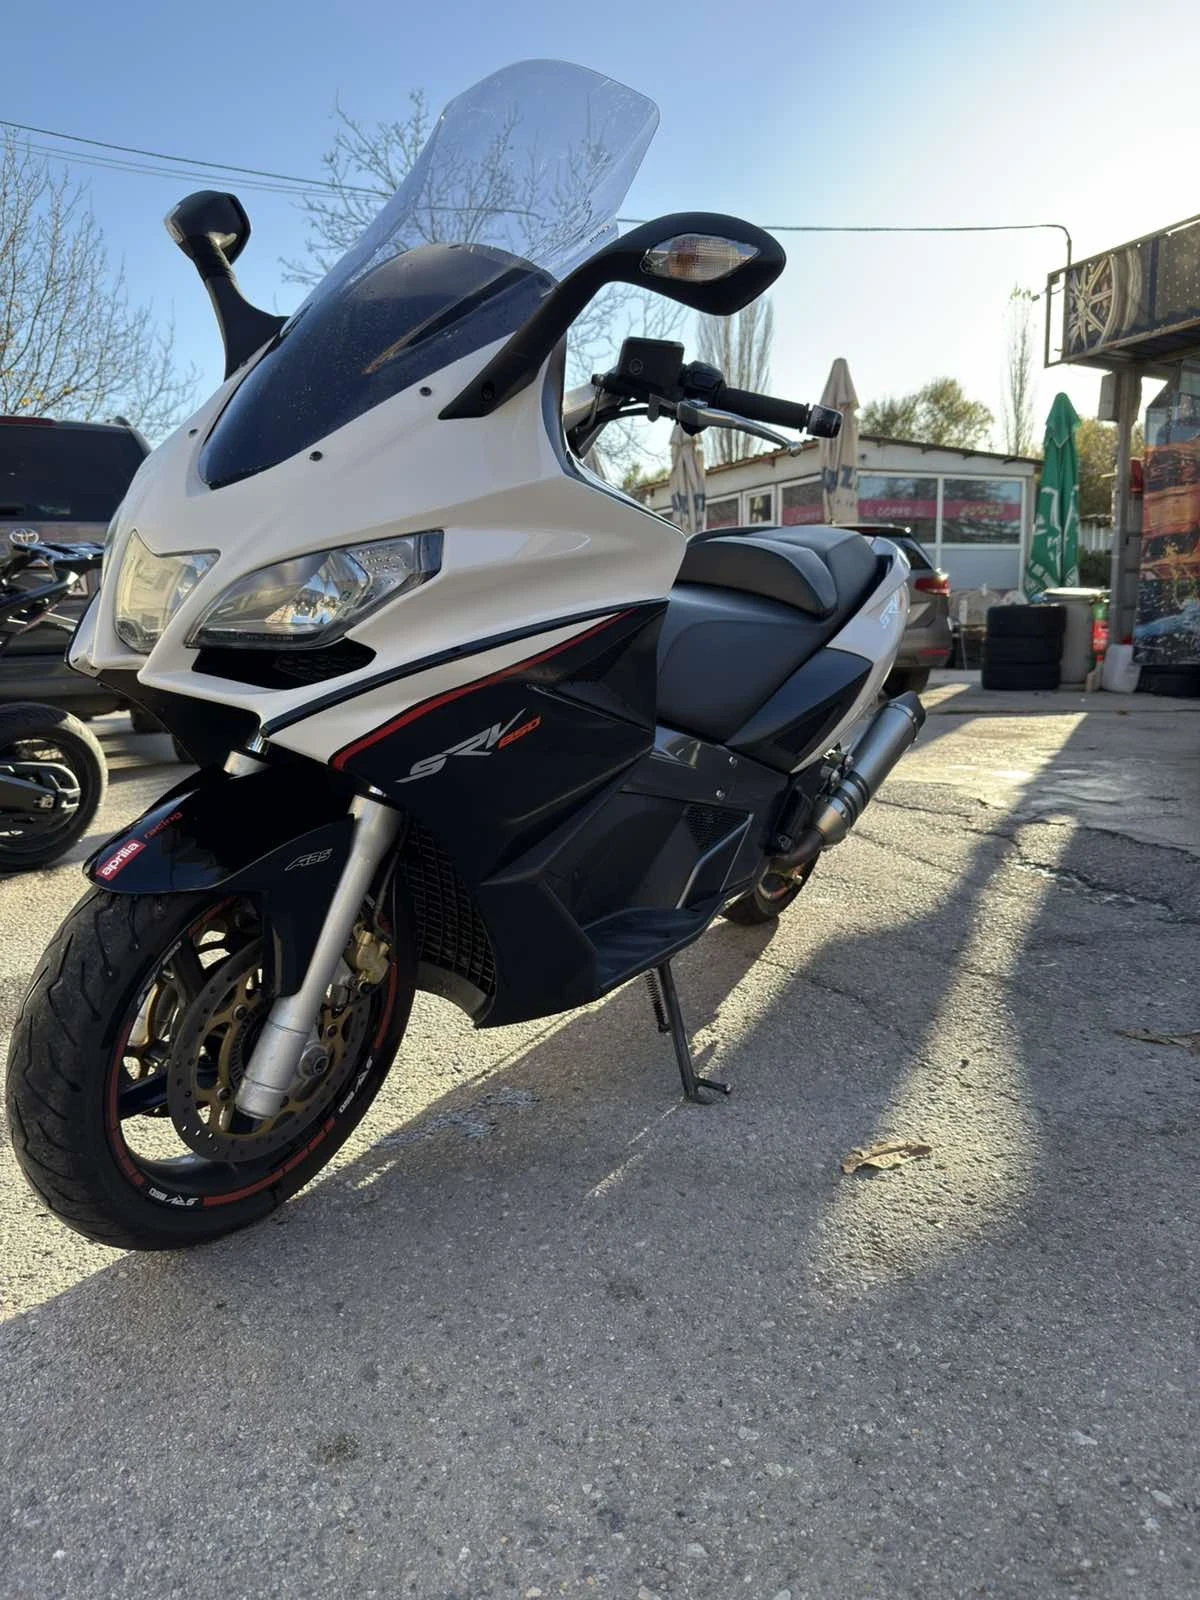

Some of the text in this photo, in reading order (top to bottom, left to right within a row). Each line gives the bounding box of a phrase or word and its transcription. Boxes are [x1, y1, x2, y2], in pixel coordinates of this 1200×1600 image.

[394, 707, 526, 783] SRV
[102, 811, 183, 876] aprilia racing
[284, 848, 333, 871] ABS
